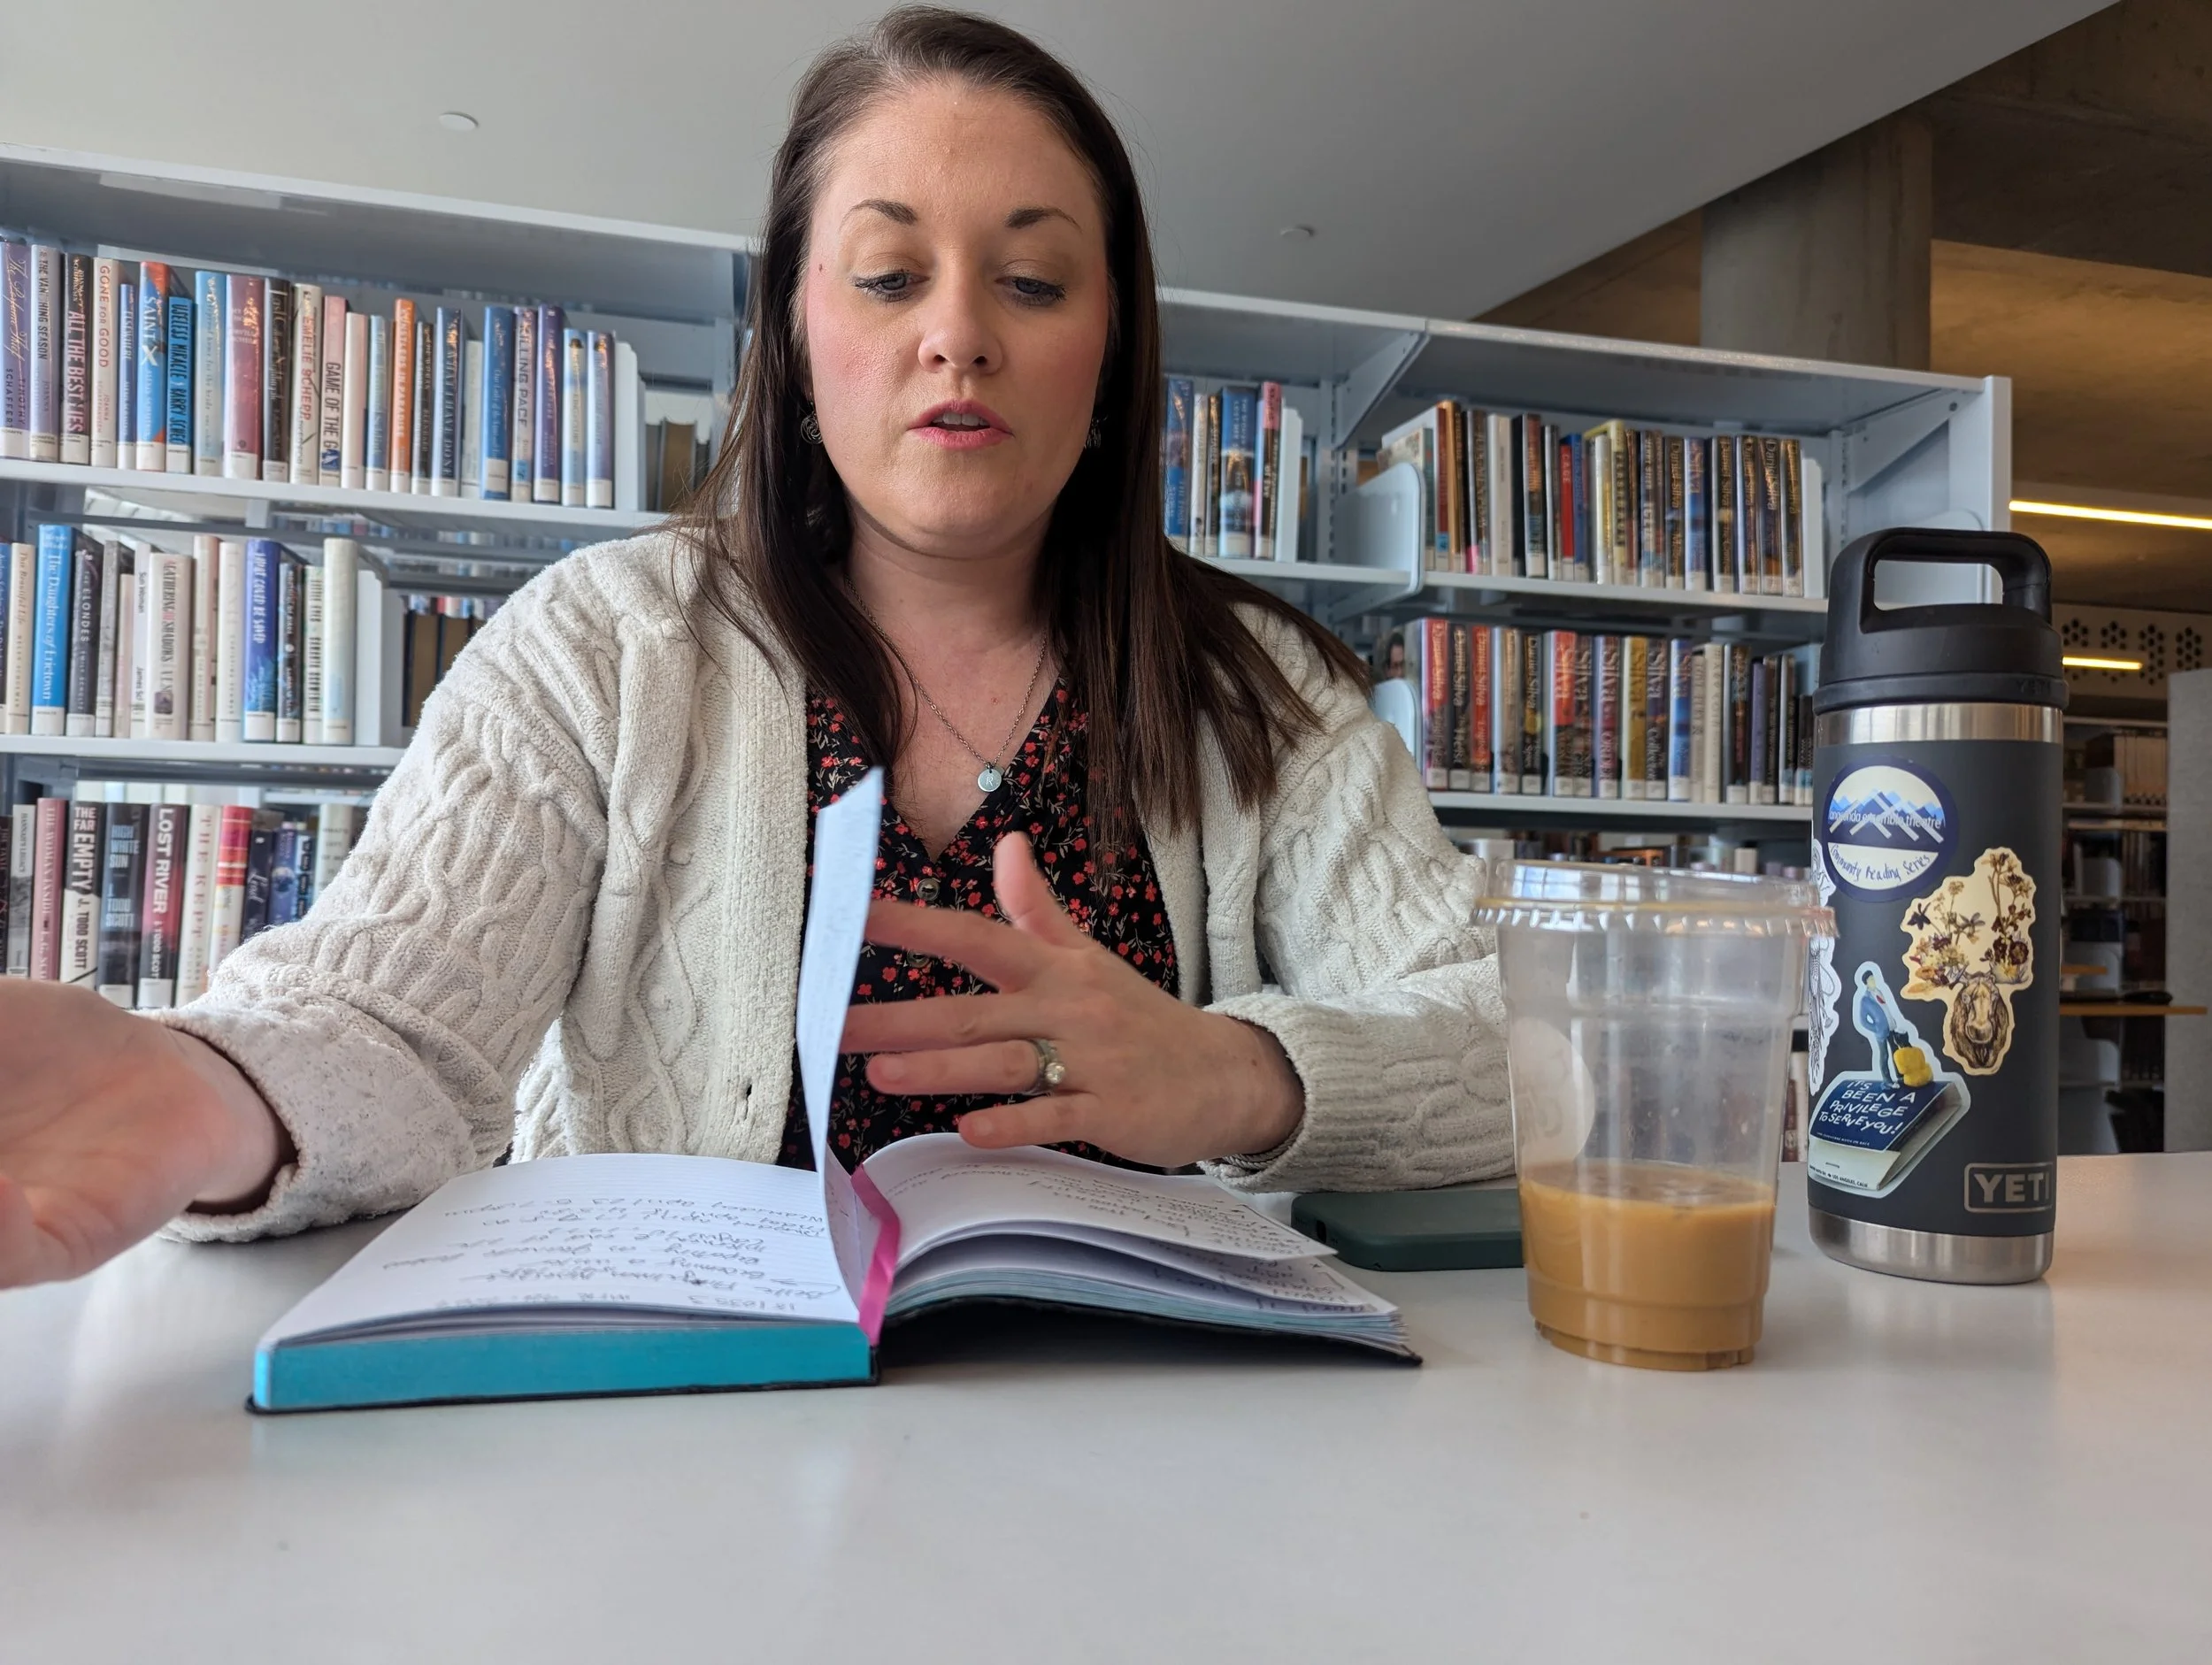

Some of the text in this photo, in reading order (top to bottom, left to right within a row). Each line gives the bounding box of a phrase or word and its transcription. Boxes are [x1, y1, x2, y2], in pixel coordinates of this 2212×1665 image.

[9, 257, 28, 279] The
[99, 265, 110, 303] GONE
[68, 311, 85, 334] ALL
[141, 295, 158, 366] SAINT X
[171, 304, 188, 341] USELESS
[302, 316, 312, 363] EMELIE
[38, 326, 47, 359] SEASON
[68, 339, 84, 363] THE
[98, 328, 109, 367] GOOD
[170, 343, 189, 378] MIRACLE
[68, 367, 84, 396] BEST
[324, 362, 341, 436] GAME OF THE
[169, 388, 189, 414] BARRY
[443, 400, 453, 434] HAVE
[442, 438, 451, 475] DONE
[1671, 442, 1682, 509] Daniel Silva
[1721, 480, 1732, 506] Silva
[1765, 441, 1778, 510] Daniel Silva
[138, 572, 147, 586] Sun
[42, 553, 61, 700] The Daughters of Erietown
[161, 565, 176, 662] GATHERING SHADOWS
[253, 619, 266, 644] SAVED
[1454, 631, 1464, 673] Daniel
[1476, 632, 1486, 706] Daniel Silva
[1432, 667, 1444, 700] Silva
[1453, 674, 1465, 707] Silva
[1525, 637, 1539, 709] Daniel Silva
[1555, 647, 1574, 700] Silva
[1573, 650, 1592, 701] Silva
[1600, 650, 1619, 703] Silva
[1630, 654, 1645, 703] Silva
[1647, 650, 1666, 699] Silva
[1674, 650, 1689, 699] Silva
[46, 807, 55, 828] THE
[73, 819, 96, 832] FAR
[74, 807, 96, 819] THE
[111, 824, 134, 839] HIGH
[111, 840, 140, 854] WHITE
[156, 809, 173, 856] LOST
[43, 832, 54, 876] WOMAN
[109, 854, 128, 869] SUN
[1830, 844, 1931, 882] Community Reading Series
[152, 860, 170, 914] RIVER
[193, 816, 211, 939] THE KEPT
[71, 833, 95, 970] EMPTY J. TODD SCOTT
[107, 898, 131, 912] TODD
[106, 912, 134, 928] SCOTT
[1841, 1089, 1916, 1103] BEEN A
[1847, 1080, 1872, 1091] IT'S
[1828, 1113, 1868, 1127] SERVE
[1860, 1122, 1903, 1135] YOU!
[1829, 1100, 1908, 1117] PRIVILEGE
[1973, 1172, 2050, 1203] YETI
